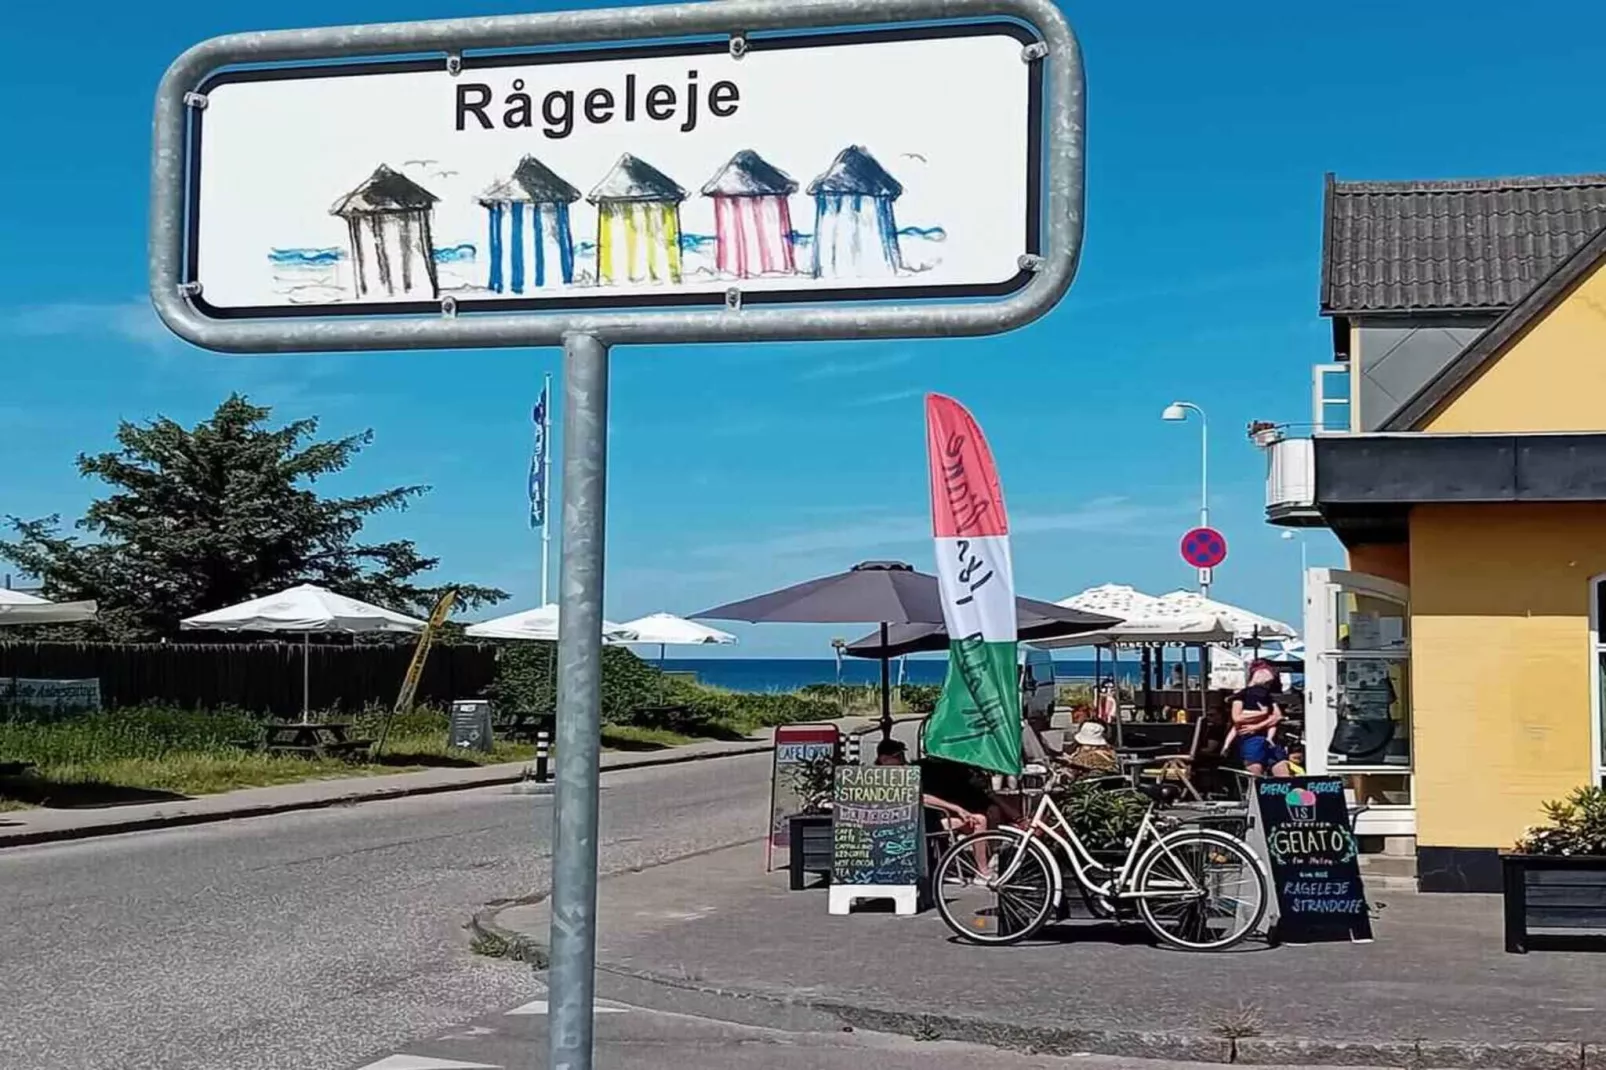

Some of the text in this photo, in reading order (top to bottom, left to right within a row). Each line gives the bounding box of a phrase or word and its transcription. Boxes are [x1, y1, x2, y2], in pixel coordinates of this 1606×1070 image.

[455, 70, 740, 139] Rågeleje
[1295, 807, 1309, 819] IS
[1273, 829, 1344, 854] GELATO
